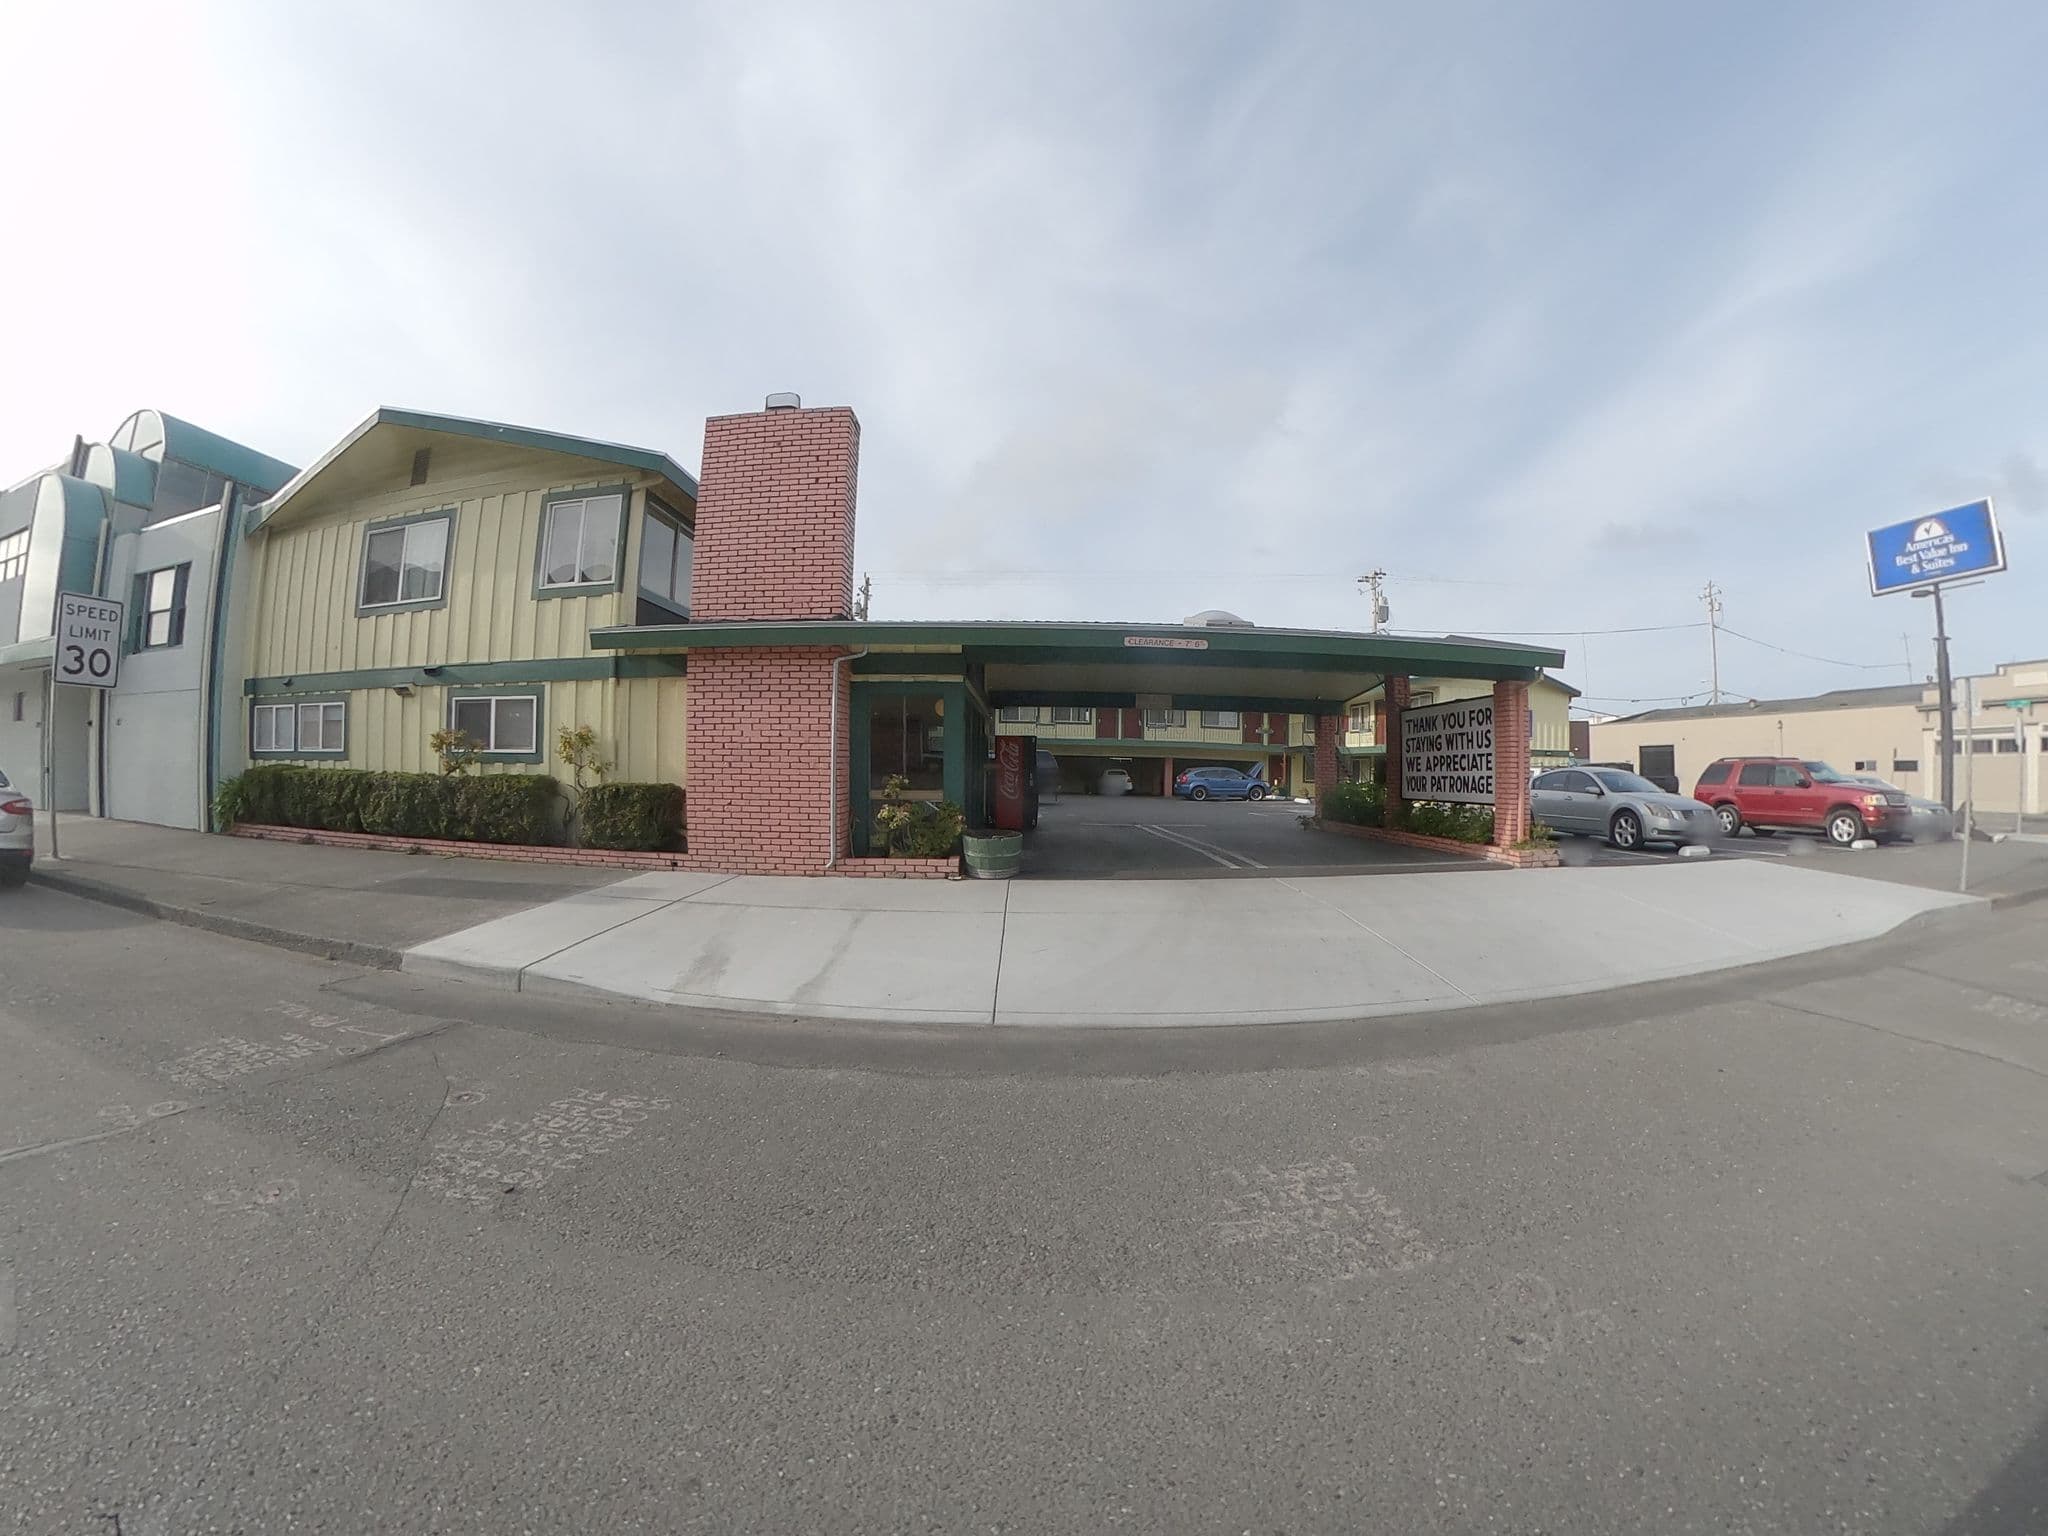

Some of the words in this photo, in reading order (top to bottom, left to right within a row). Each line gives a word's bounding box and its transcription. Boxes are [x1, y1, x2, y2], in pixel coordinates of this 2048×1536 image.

[1949, 542, 1968, 554] Inn
[66, 603, 118, 622] SPEED
[69, 625, 112, 642] LIMIT
[1128, 638, 1174, 647] CLEARANCE
[62, 645, 111, 677] 30
[1405, 714, 1439, 734] THANK
[1441, 711, 1466, 730] YOU
[1469, 707, 1492, 727] FOR
[1405, 734, 1442, 753] STAYING
[1445, 731, 1474, 751] WITH
[1476, 729, 1492, 749] US
[1405, 756, 1421, 772] WE
[1425, 752, 1493, 772] APPRECIATE
[1405, 775, 1427, 792] YOUR
[1430, 775, 1493, 794] PATRONAGE
